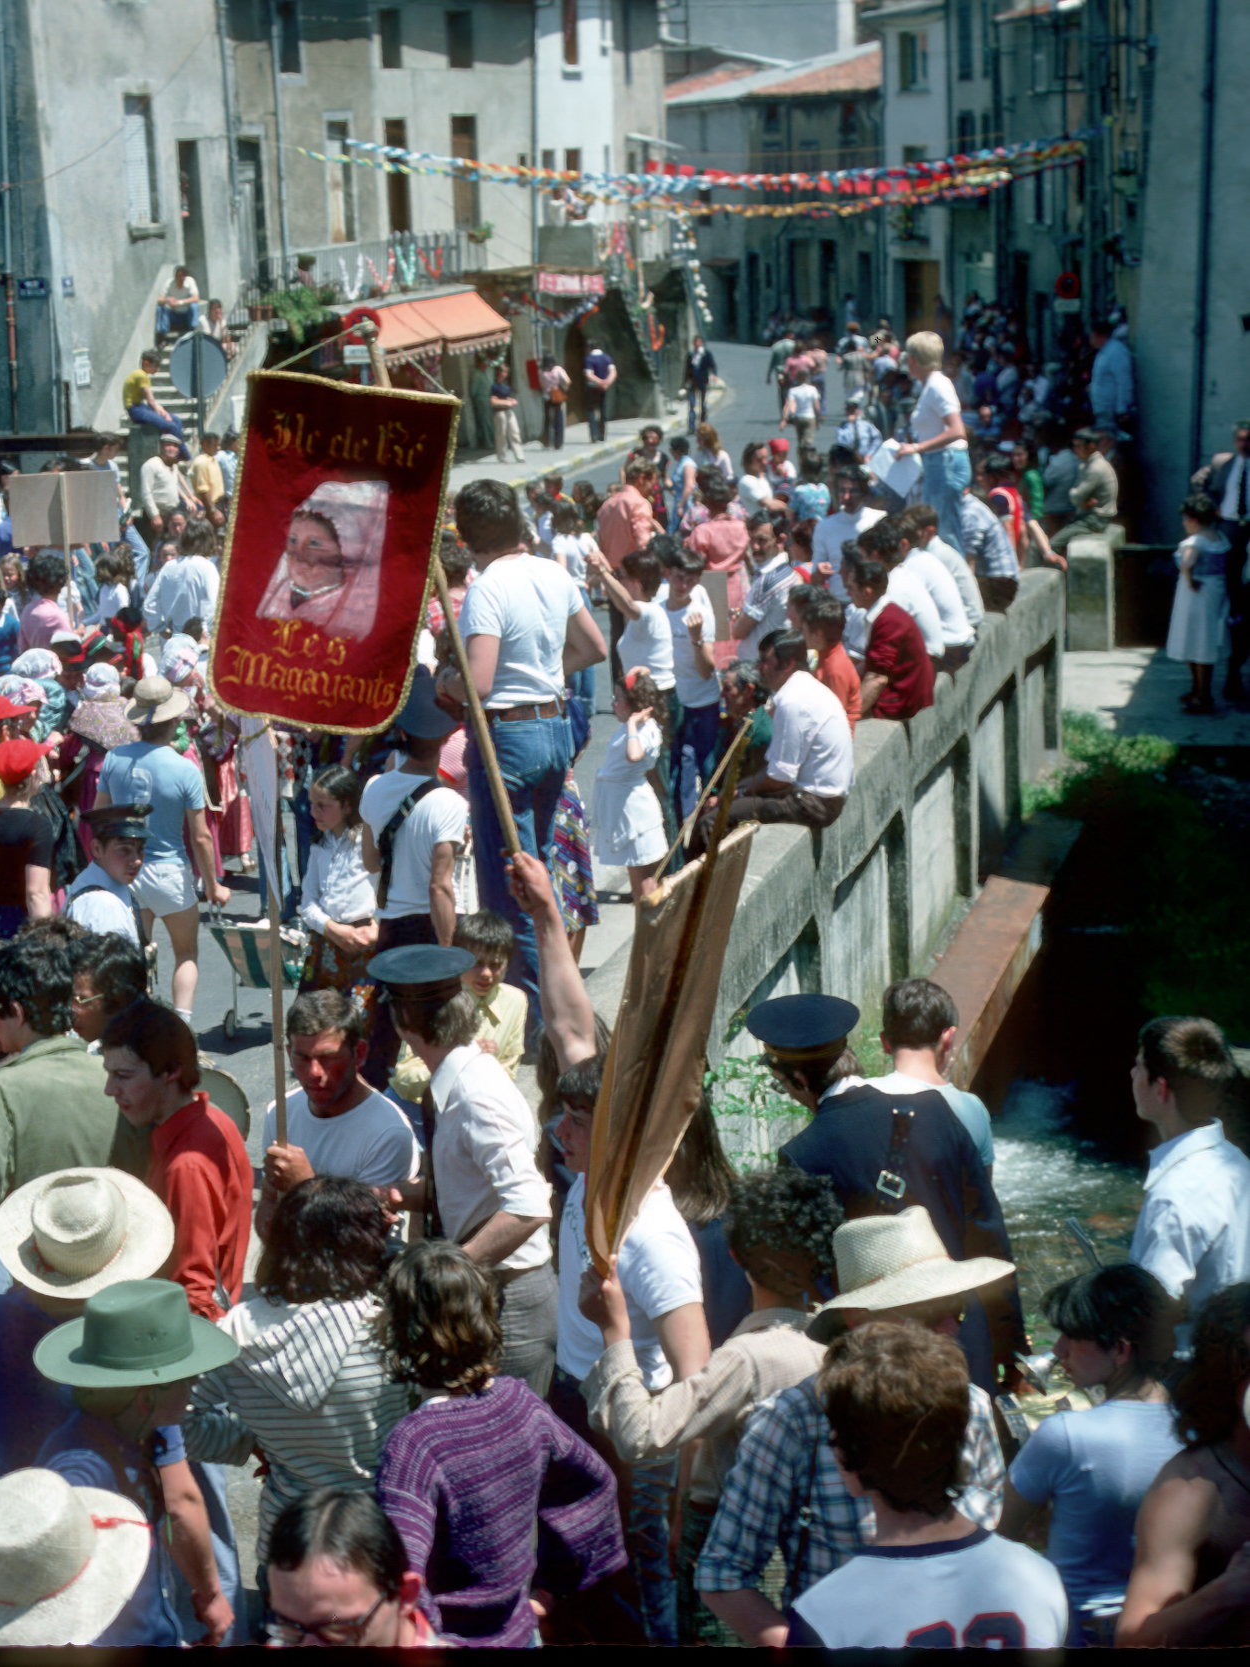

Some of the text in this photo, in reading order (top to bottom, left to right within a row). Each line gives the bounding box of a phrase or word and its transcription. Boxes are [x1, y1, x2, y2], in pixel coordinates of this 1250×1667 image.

[329, 425, 368, 462] de
[376, 420, 426, 467] Ré
[271, 617, 352, 665] Les
[219, 645, 397, 709] Magayants
